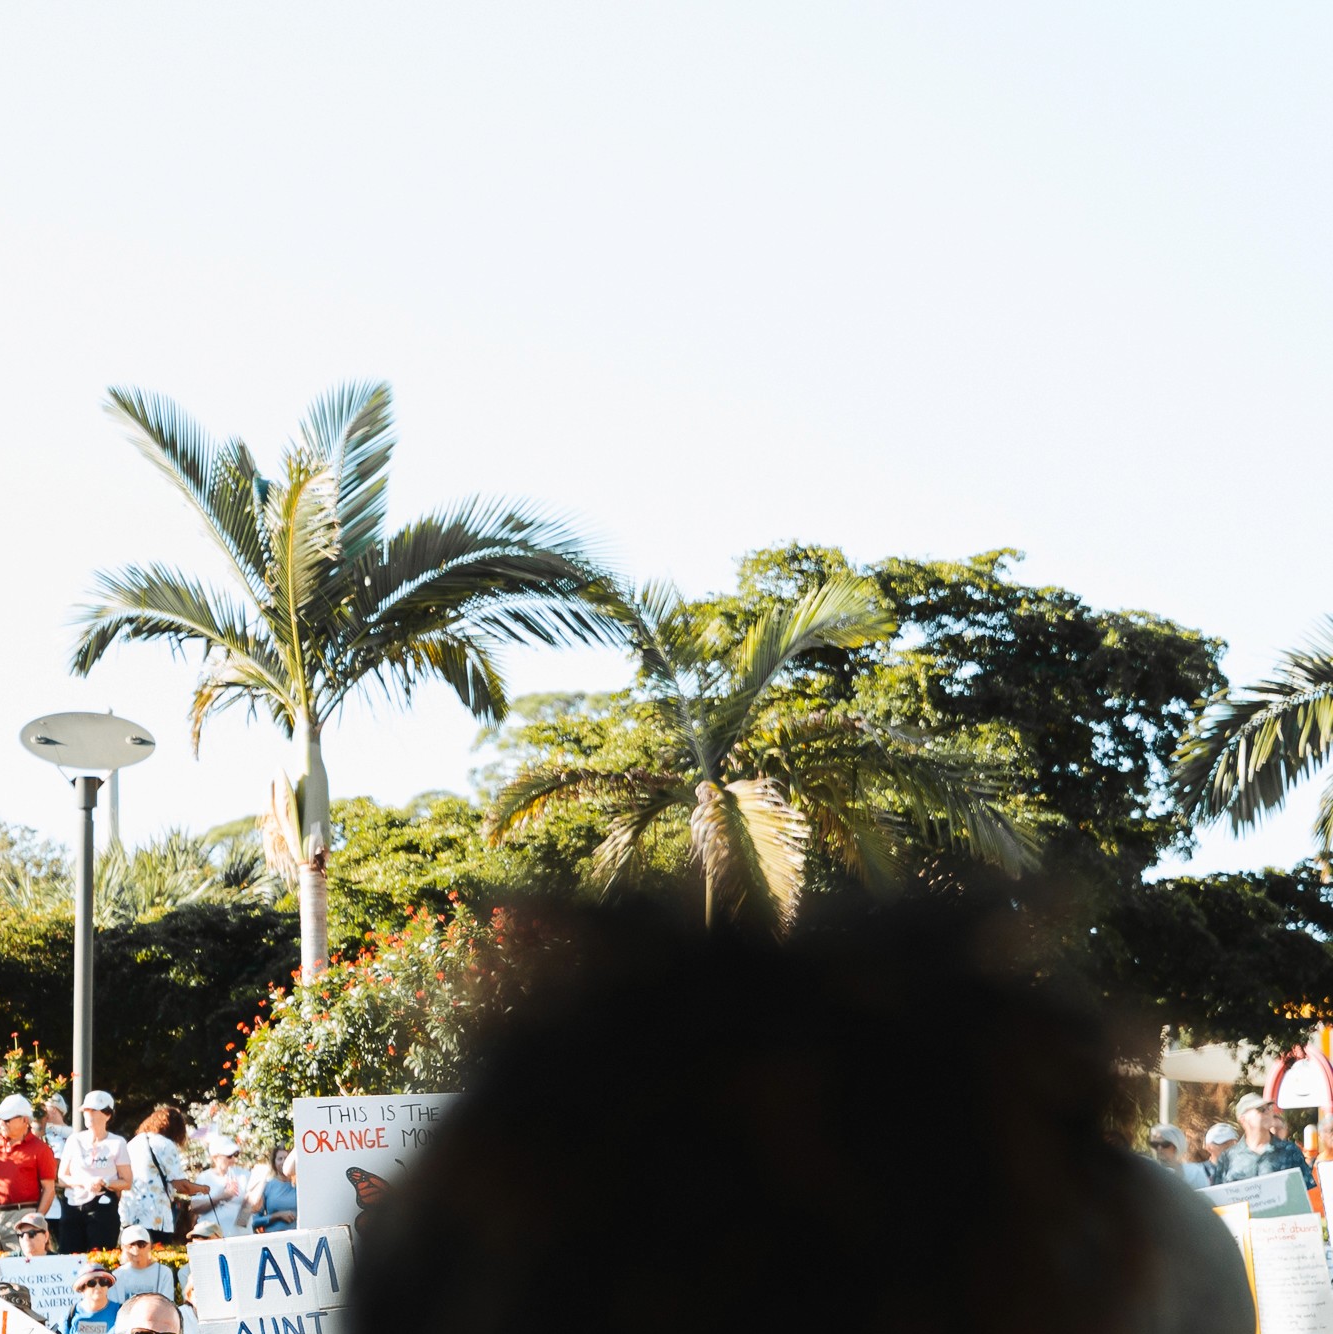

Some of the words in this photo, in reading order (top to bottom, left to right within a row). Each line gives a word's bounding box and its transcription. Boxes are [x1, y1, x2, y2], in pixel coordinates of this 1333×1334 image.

[317, 1105, 367, 1124] THIS
[381, 1105, 395, 1121] IS
[401, 1104, 440, 1122] THE
[302, 1127, 389, 1153] ORANGE
[219, 1254, 231, 1301] I
[255, 1236, 339, 1299] AM
[0, 1273, 63, 1285] CONGRESS
[41, 1286, 73, 1296] NATIO
[36, 1299, 75, 1309] AMERIC
[79, 1323, 107, 1334] RESIST
